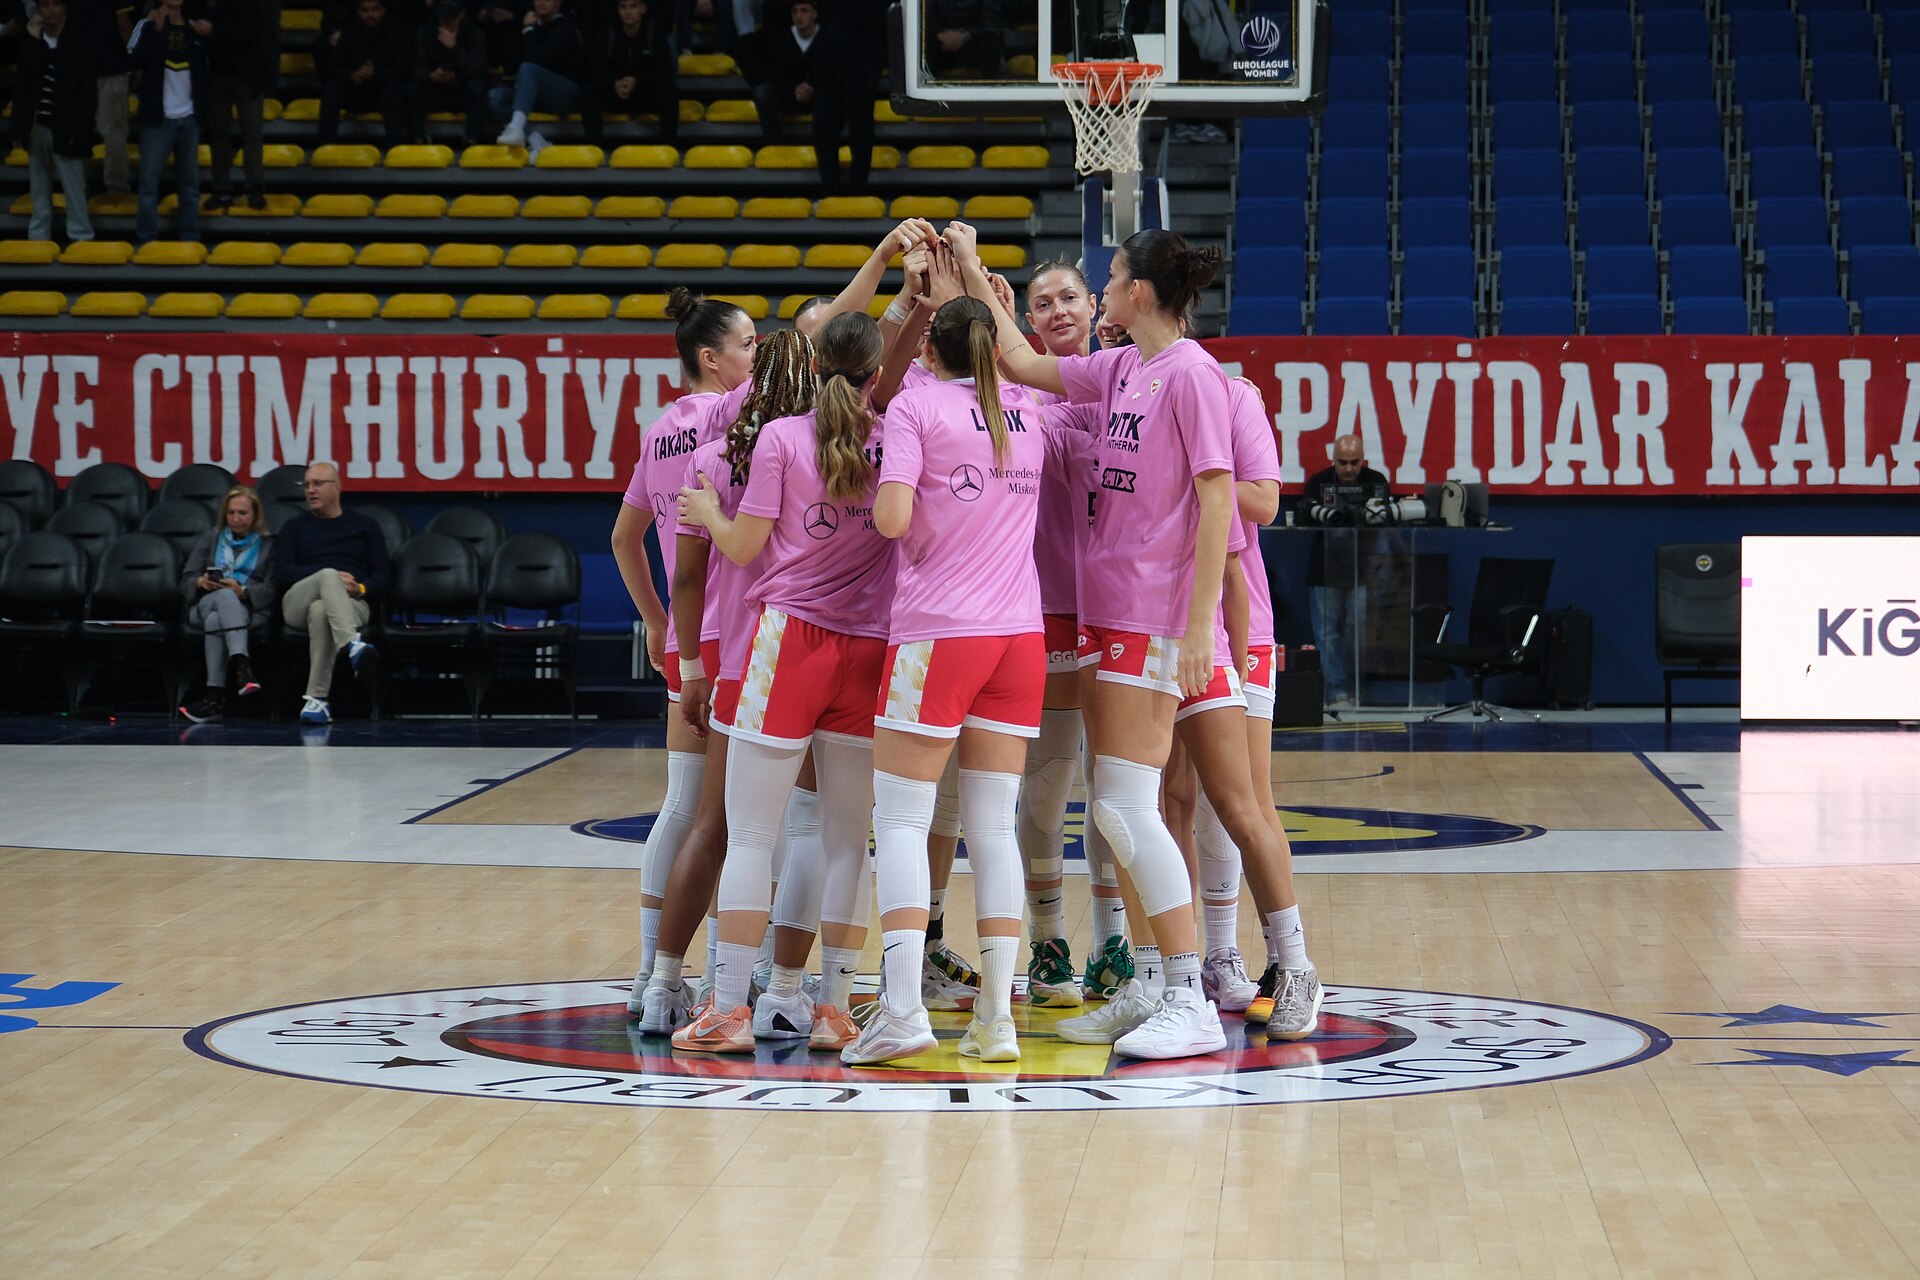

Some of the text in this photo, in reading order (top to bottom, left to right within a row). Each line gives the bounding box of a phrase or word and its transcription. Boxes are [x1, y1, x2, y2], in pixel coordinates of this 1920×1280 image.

[1233, 60, 1290, 70] EUROLEAGUE
[1244, 69, 1279, 78] WOMEN
[1274, 343, 1676, 486] PAYİDAR
[267, 1011, 447, 1046] 1907
[1276, 1036, 1587, 1086] SPOR
[473, 1075, 1258, 1106] KULÜBÜ
